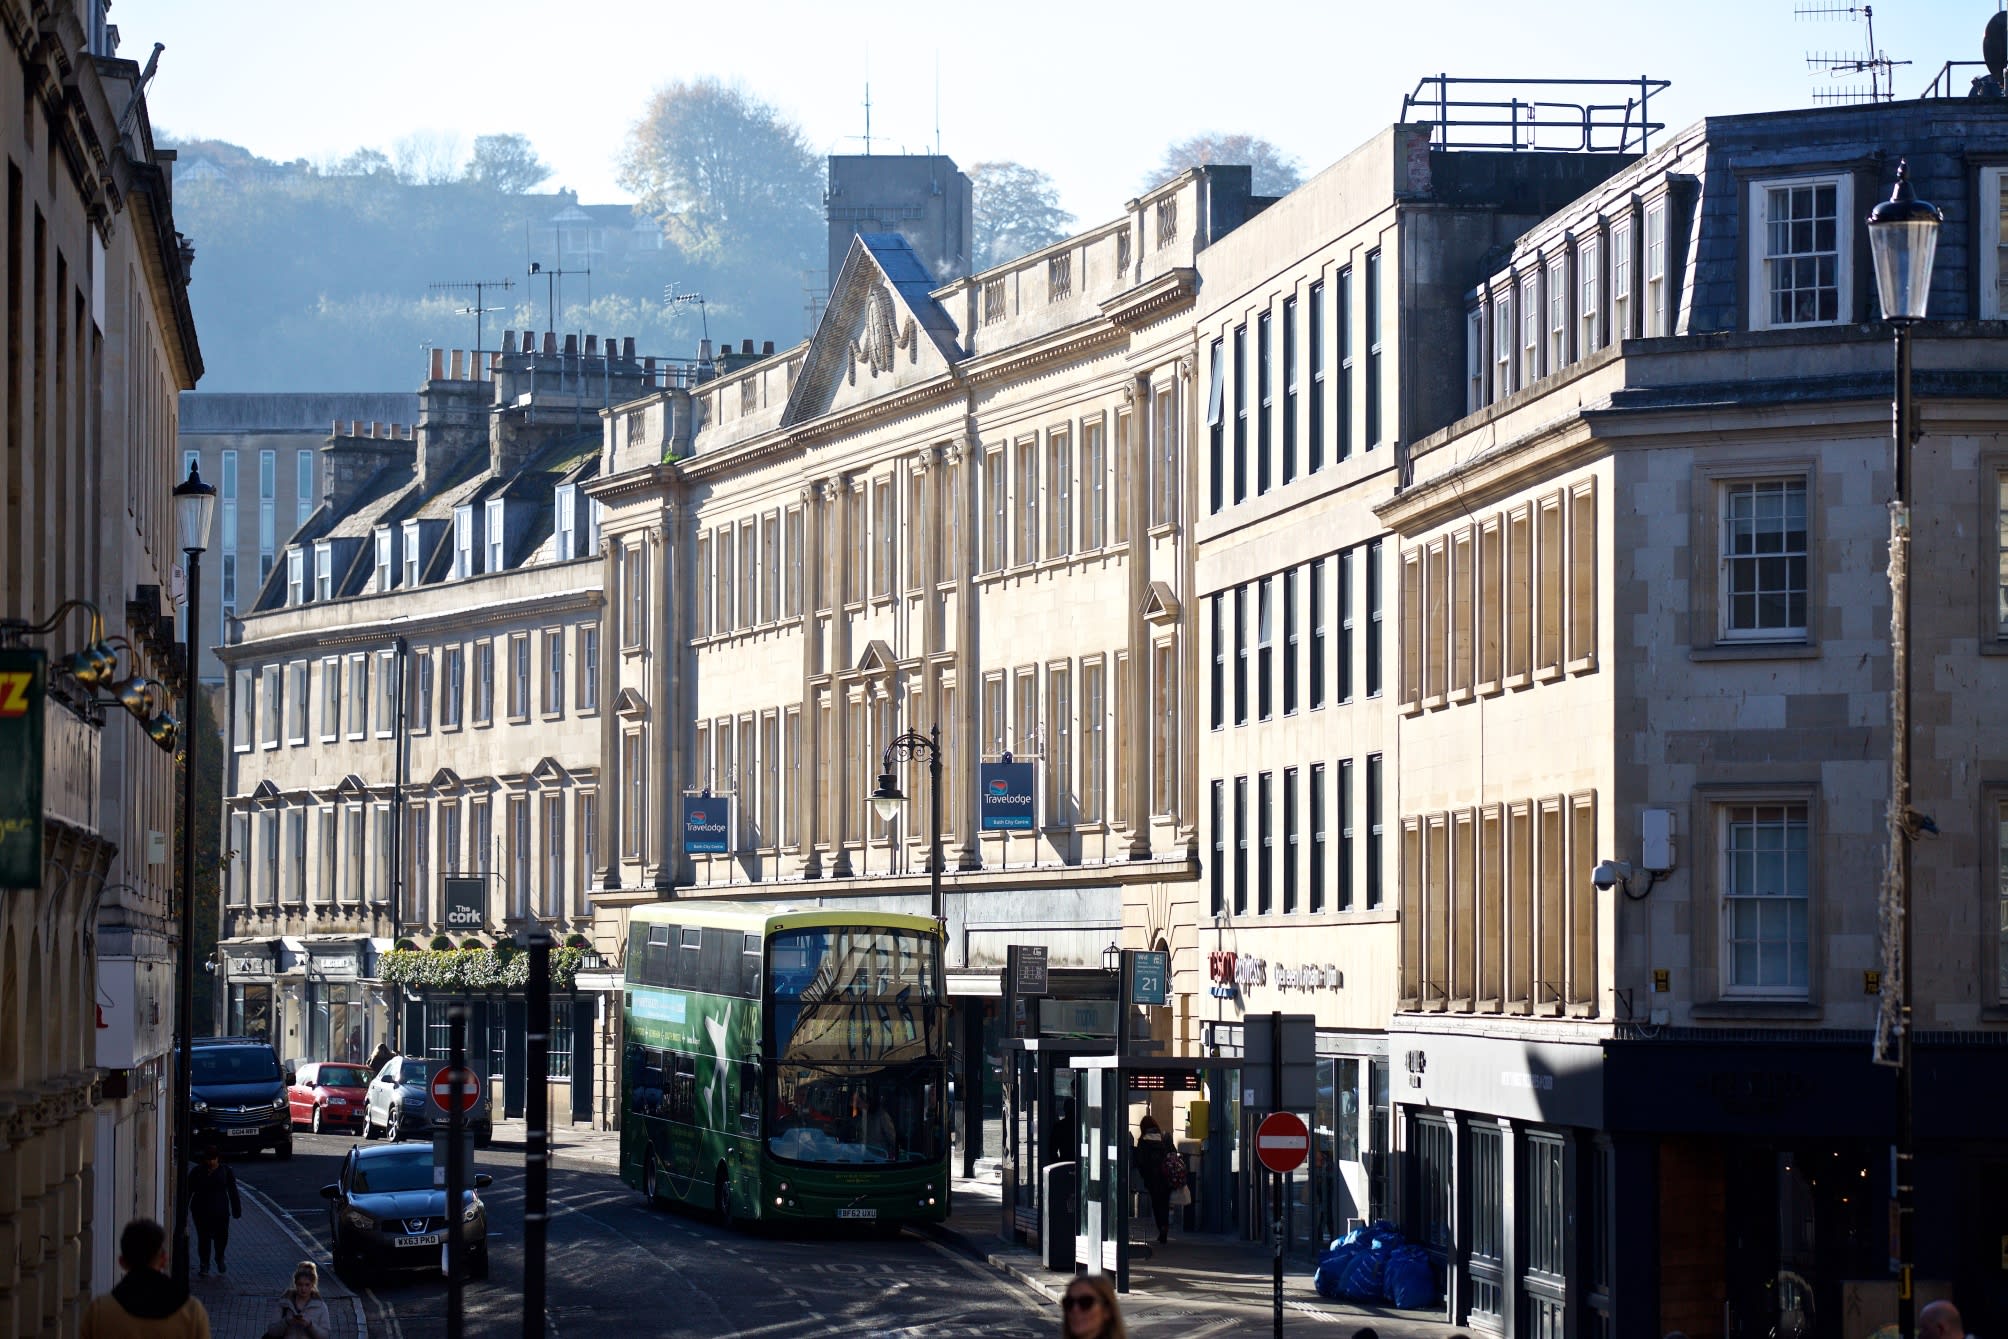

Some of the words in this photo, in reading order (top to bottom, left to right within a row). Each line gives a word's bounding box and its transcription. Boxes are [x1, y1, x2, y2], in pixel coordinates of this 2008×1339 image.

[984, 794, 1031, 805] Travelodge
[686, 822, 726, 832] Travelodge
[455, 904, 470, 912] The
[449, 909, 480, 923] cork
[1142, 976, 1157, 991] 21
[740, 1005, 758, 1040] AIR
[397, 1237, 419, 1246] WX63
